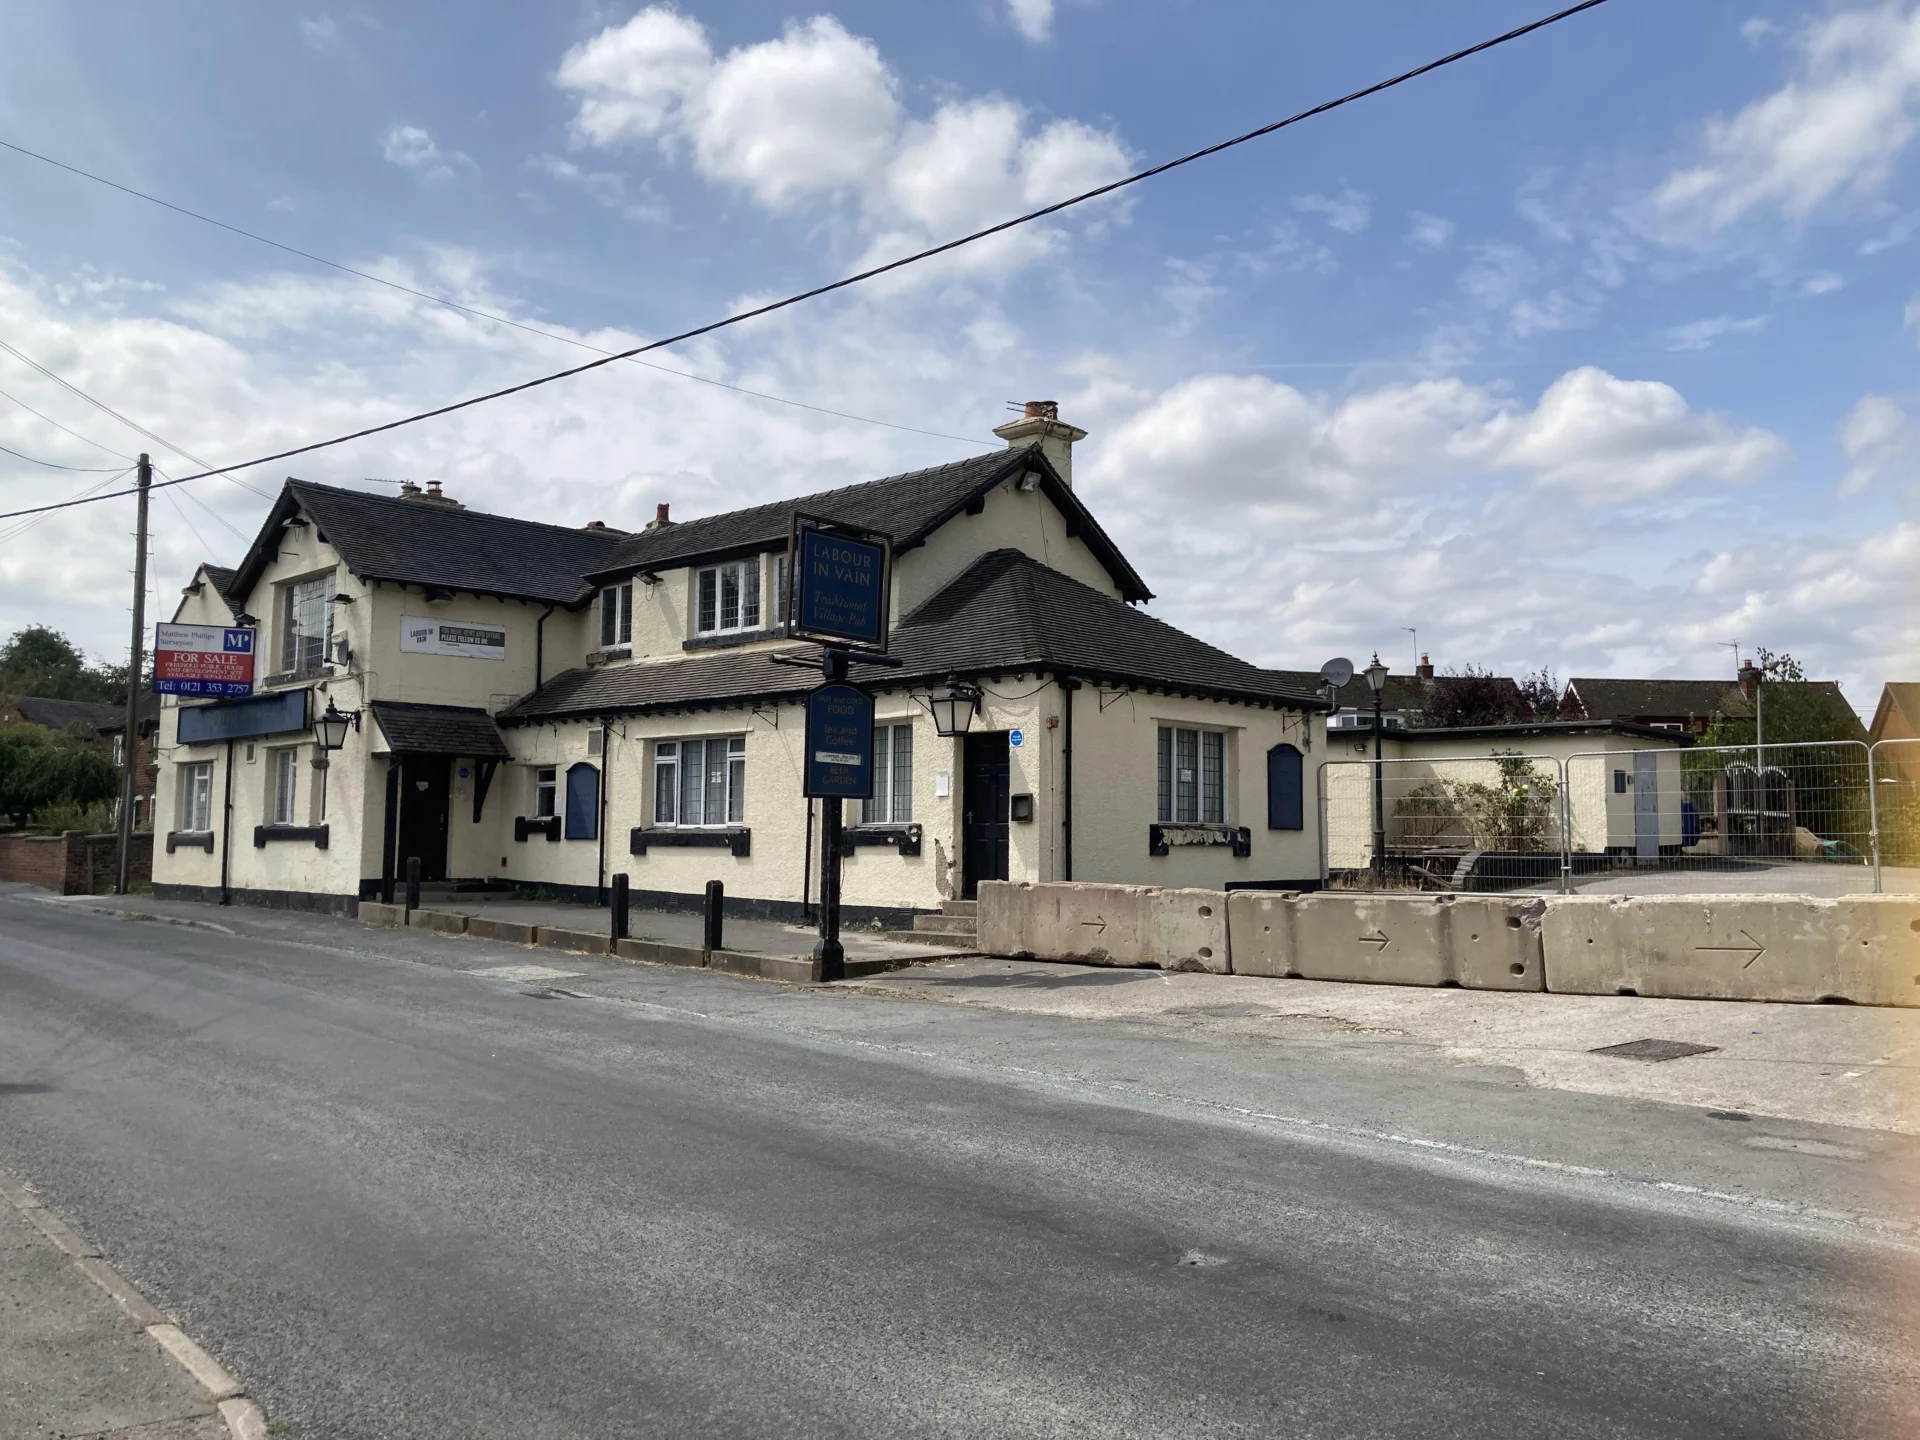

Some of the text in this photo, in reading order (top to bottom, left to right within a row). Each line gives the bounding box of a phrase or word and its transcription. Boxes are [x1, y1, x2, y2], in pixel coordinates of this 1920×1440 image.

[814, 544, 870, 568] LABOUR
[814, 562, 870, 586] IN VAIN
[814, 590, 868, 612] Traditional
[814, 606, 866, 626] Village Pub
[192, 632, 215, 640] Phillips
[410, 629, 427, 637] LABOUR
[174, 652, 238, 664] FOR SALE
[158, 680, 249, 693] Tel: 0121 353 2757
[828, 705, 854, 715] FOOD
[824, 724, 857, 735] Tea and
[826, 735, 854, 745] Coffee
[830, 766, 848, 774] BEER
[823, 776, 856, 784] GARDEN
